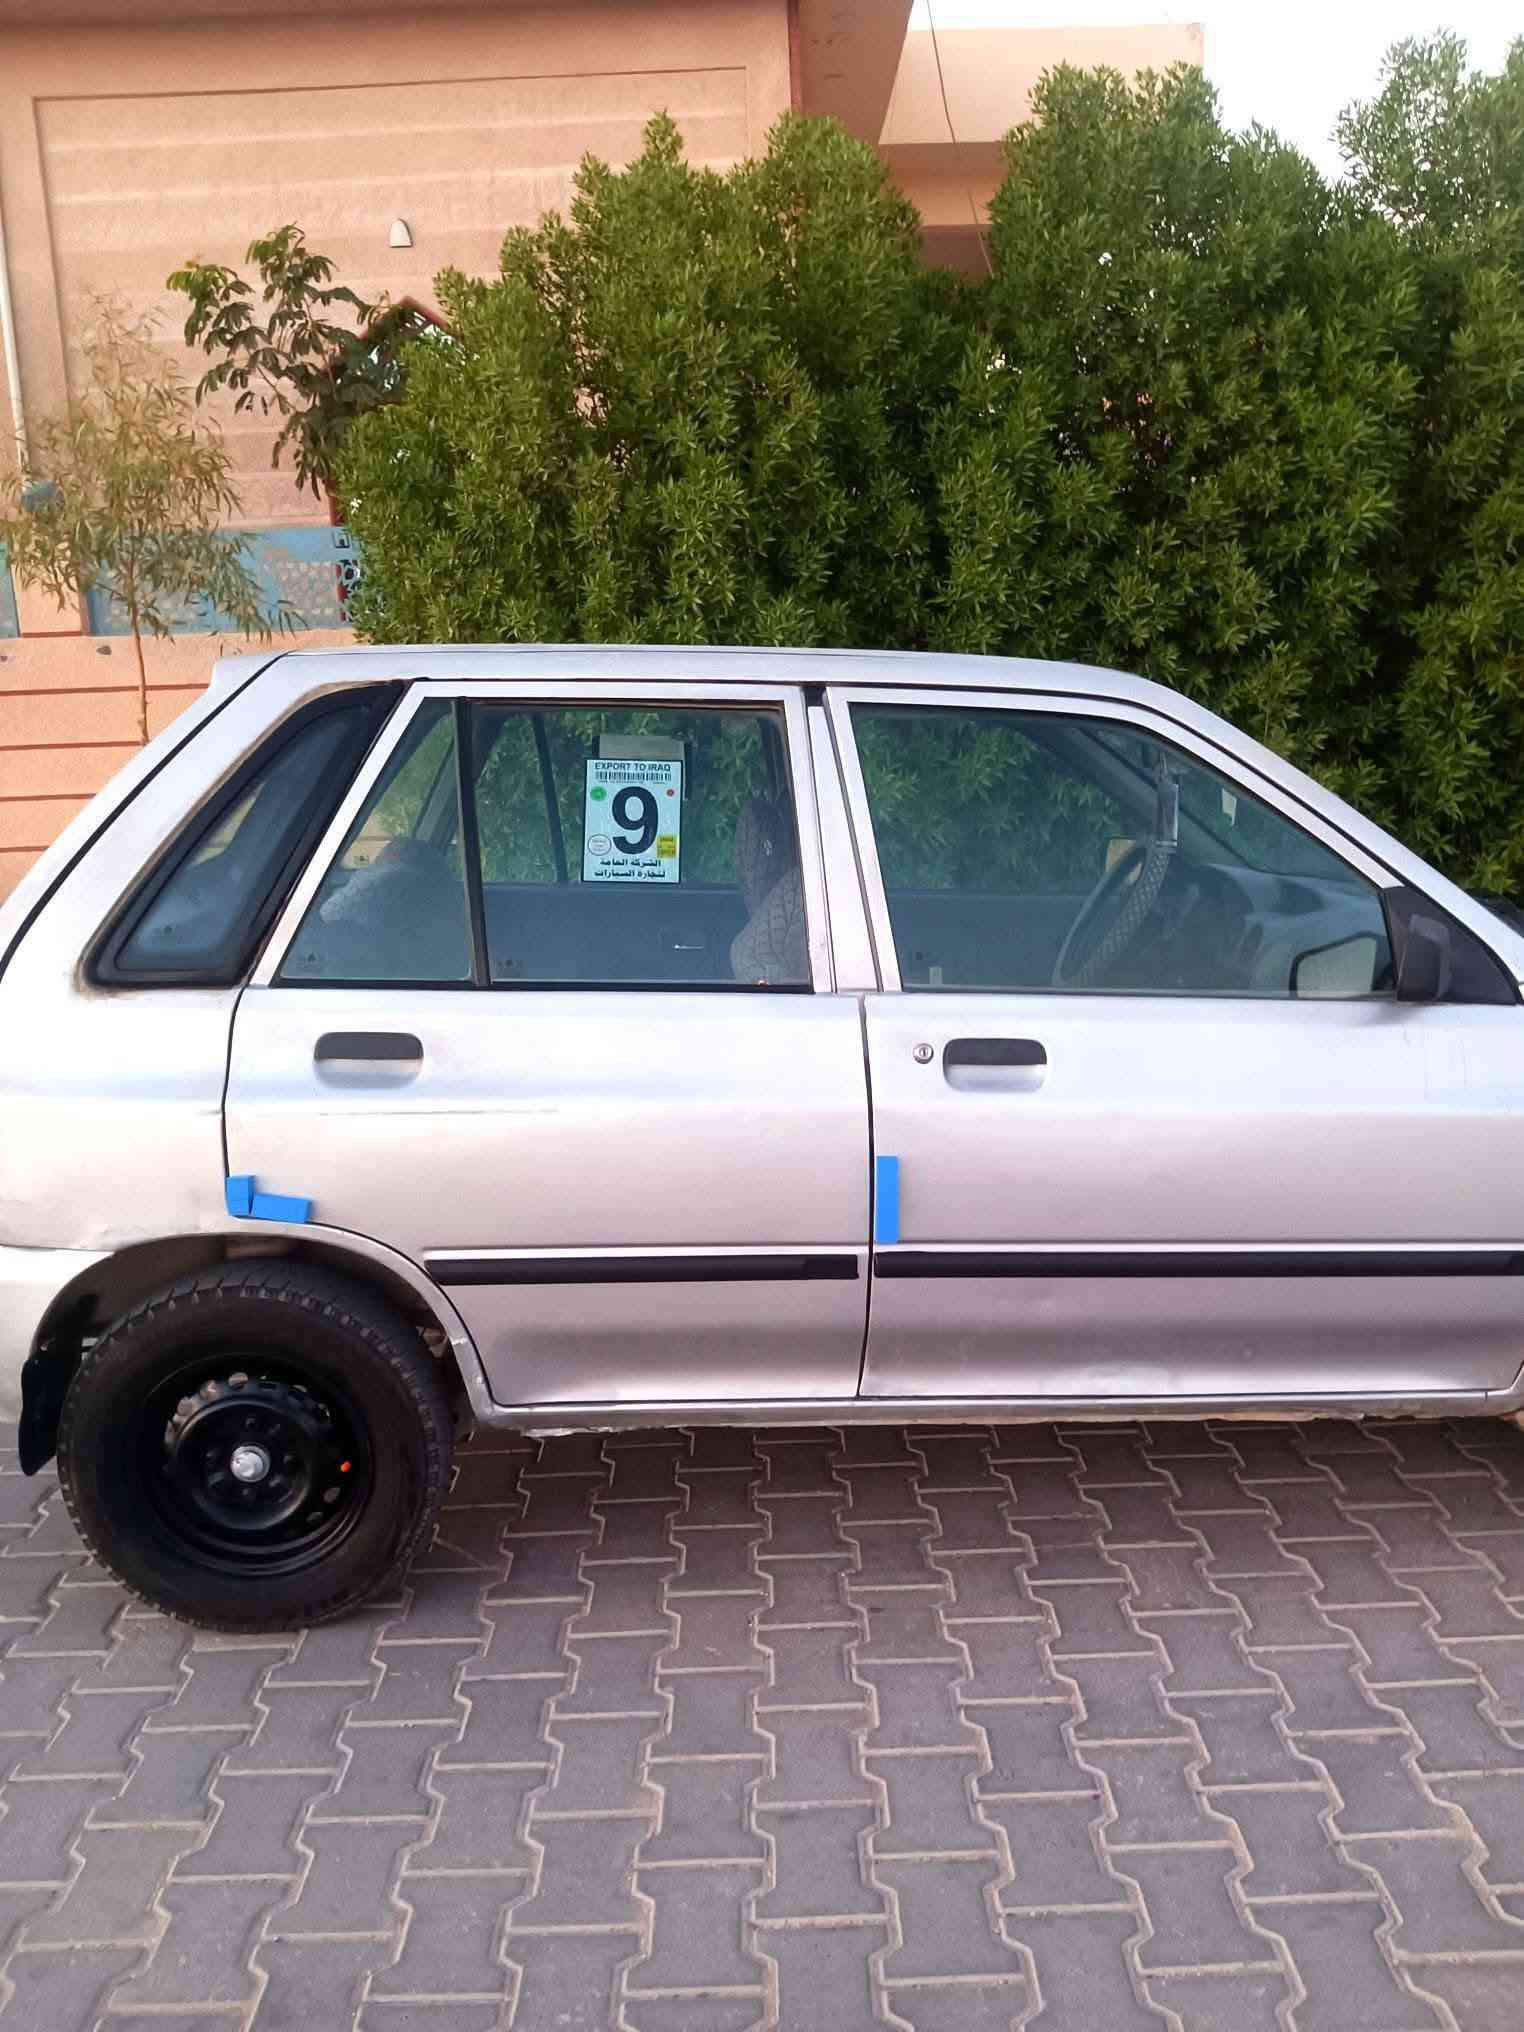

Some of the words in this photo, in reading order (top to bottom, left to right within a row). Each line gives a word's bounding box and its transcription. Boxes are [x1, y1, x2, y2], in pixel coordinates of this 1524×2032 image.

[633, 763, 646, 771] TO
[648, 763, 671, 771] IRAQ
[612, 786, 658, 854] 9
